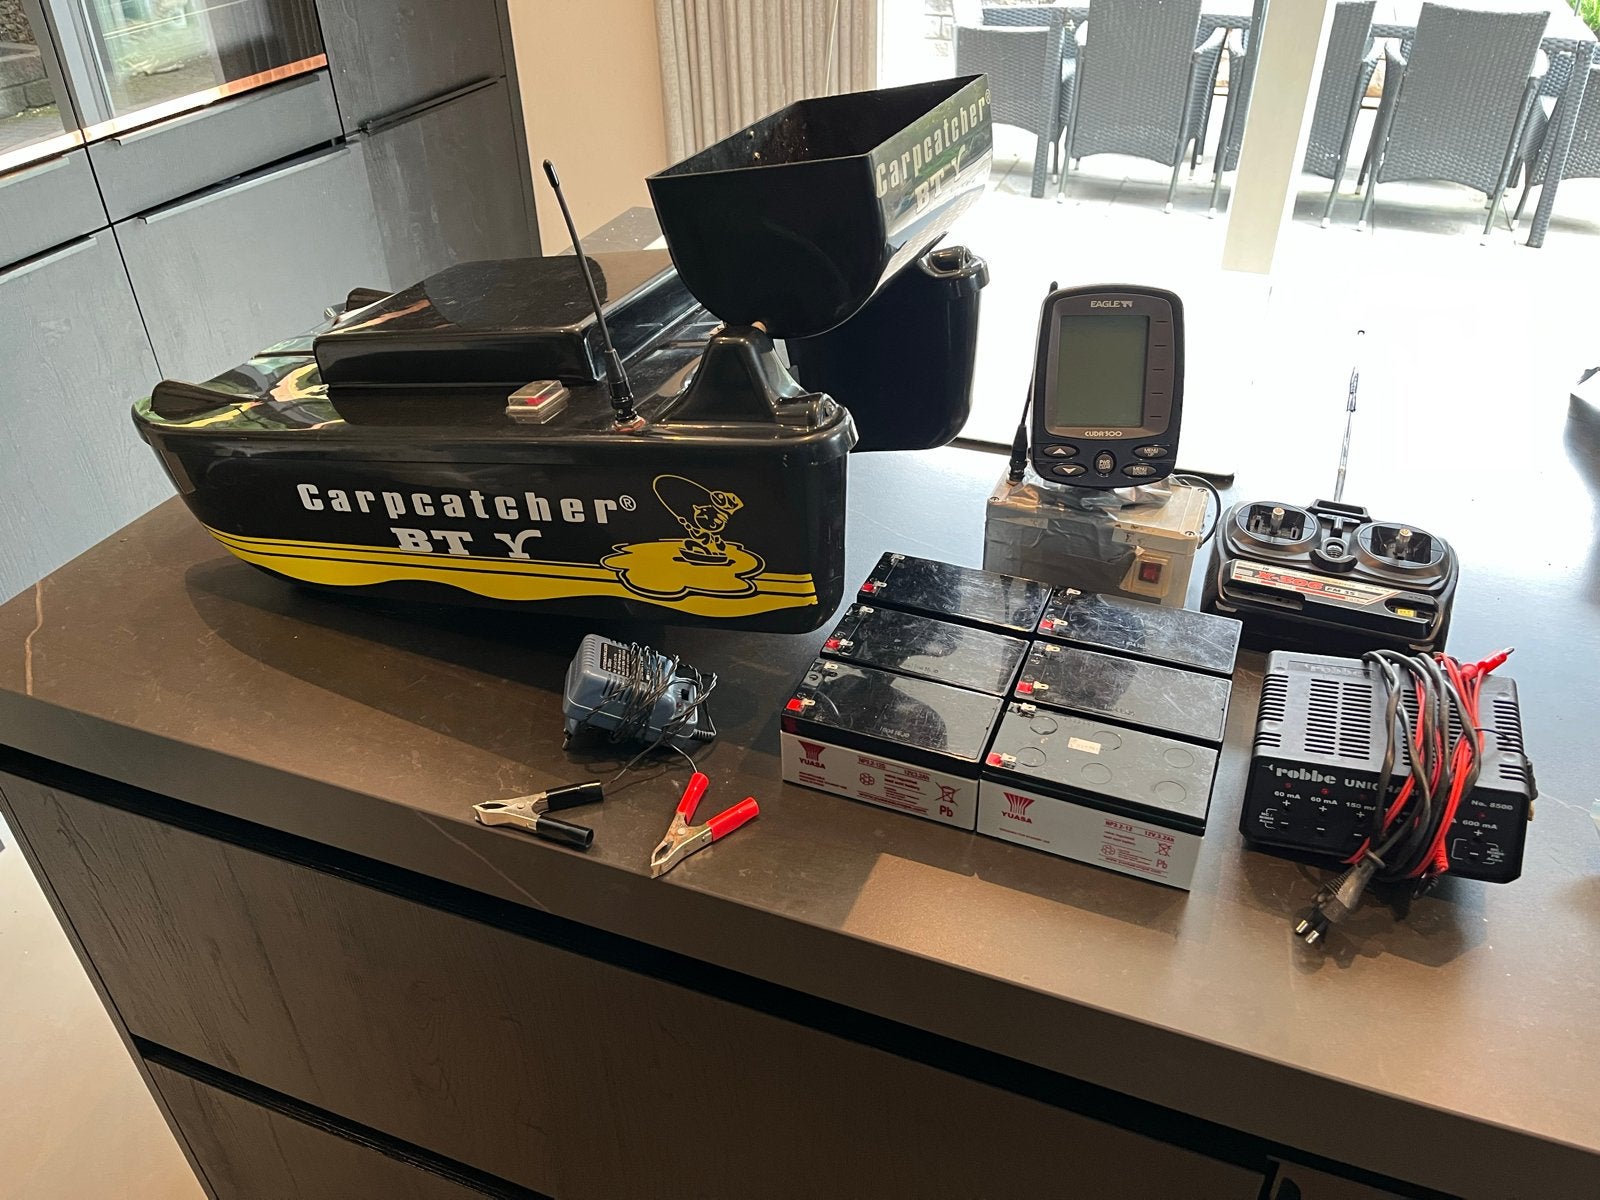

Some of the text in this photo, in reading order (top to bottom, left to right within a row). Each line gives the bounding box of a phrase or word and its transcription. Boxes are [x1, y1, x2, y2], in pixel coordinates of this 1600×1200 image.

[1090, 300, 1121, 308] EAGLE
[389, 526, 542, 560] BT Y
[799, 757, 826, 770] YUASA
[1275, 767, 1337, 785] robbe
[1286, 792, 1301, 800] mA
[939, 804, 954, 818] Pb
[1001, 811, 1033, 825] YUASA
[1462, 819, 1480, 827] 600
[1482, 822, 1498, 830] mA
[1155, 858, 1169, 869] Pb
